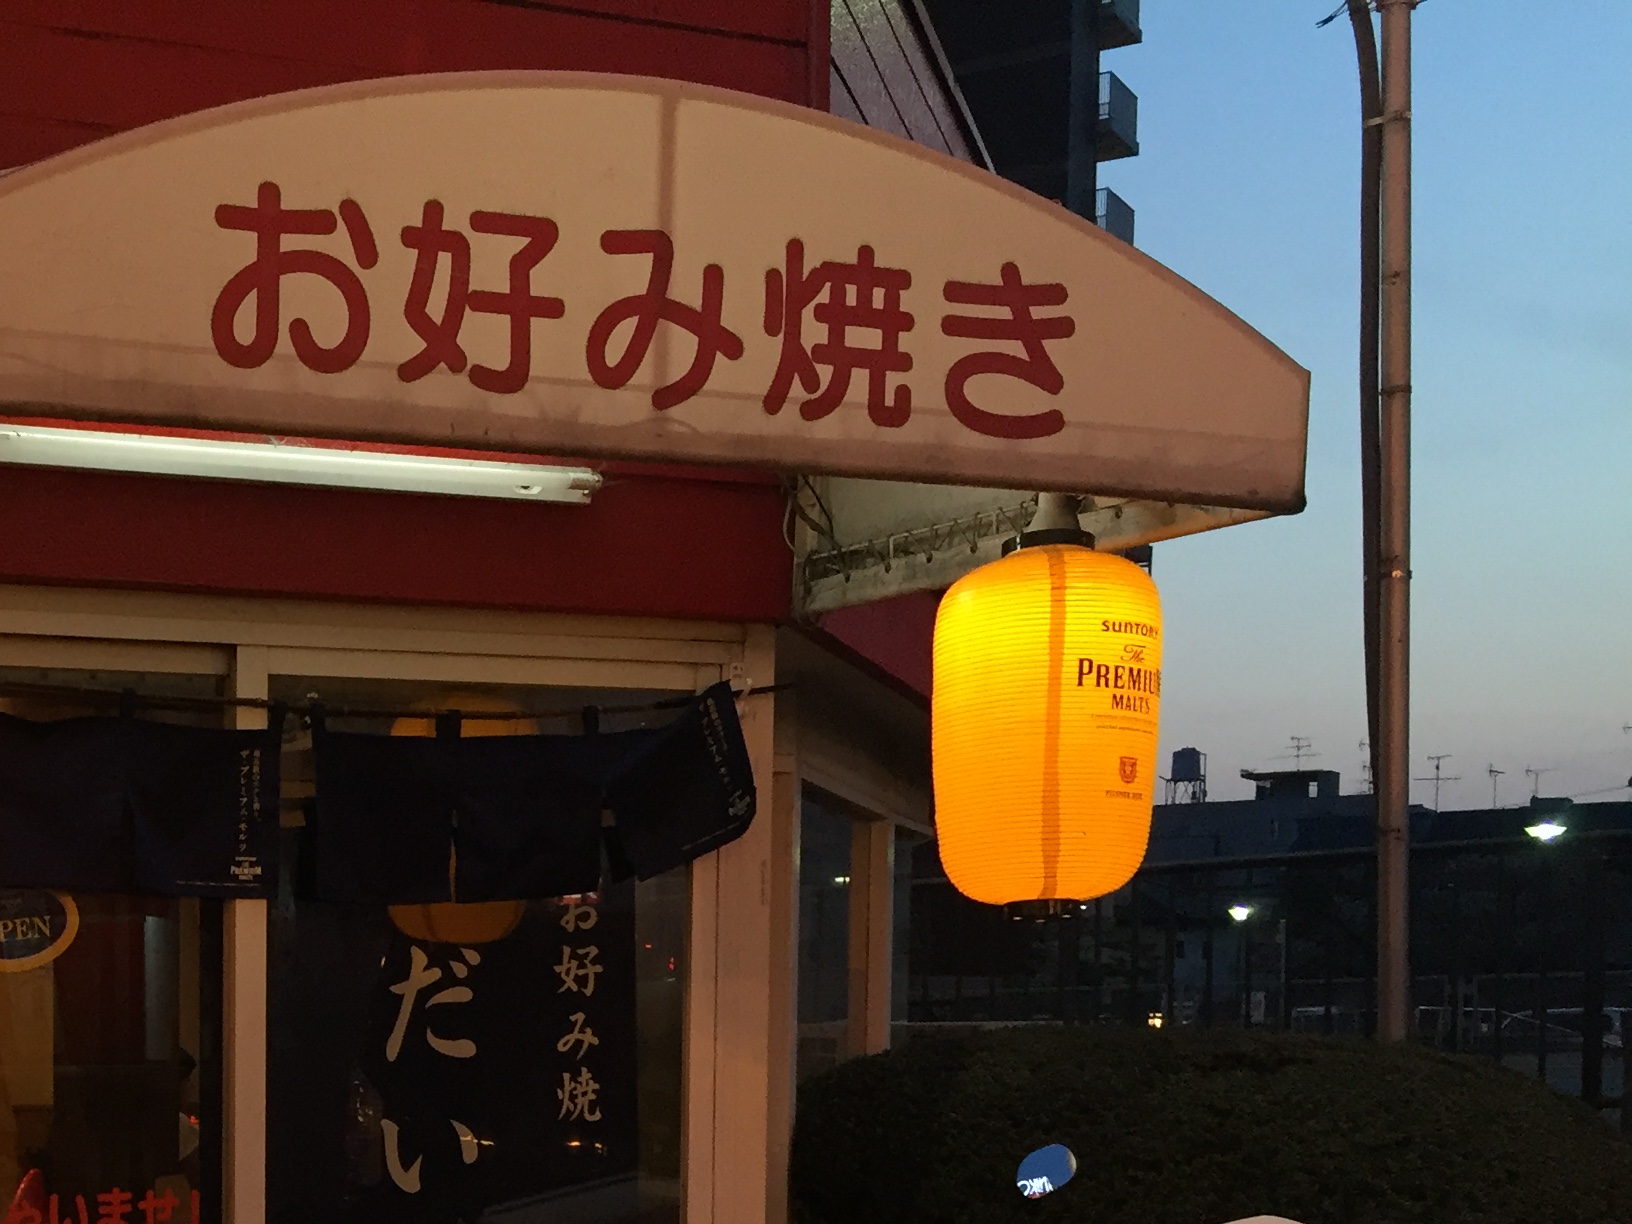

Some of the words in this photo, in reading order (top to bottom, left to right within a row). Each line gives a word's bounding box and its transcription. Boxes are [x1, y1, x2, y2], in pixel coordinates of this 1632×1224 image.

[211, 181, 1076, 438] お好み焼き
[553, 897, 604, 1123] お好み焼
